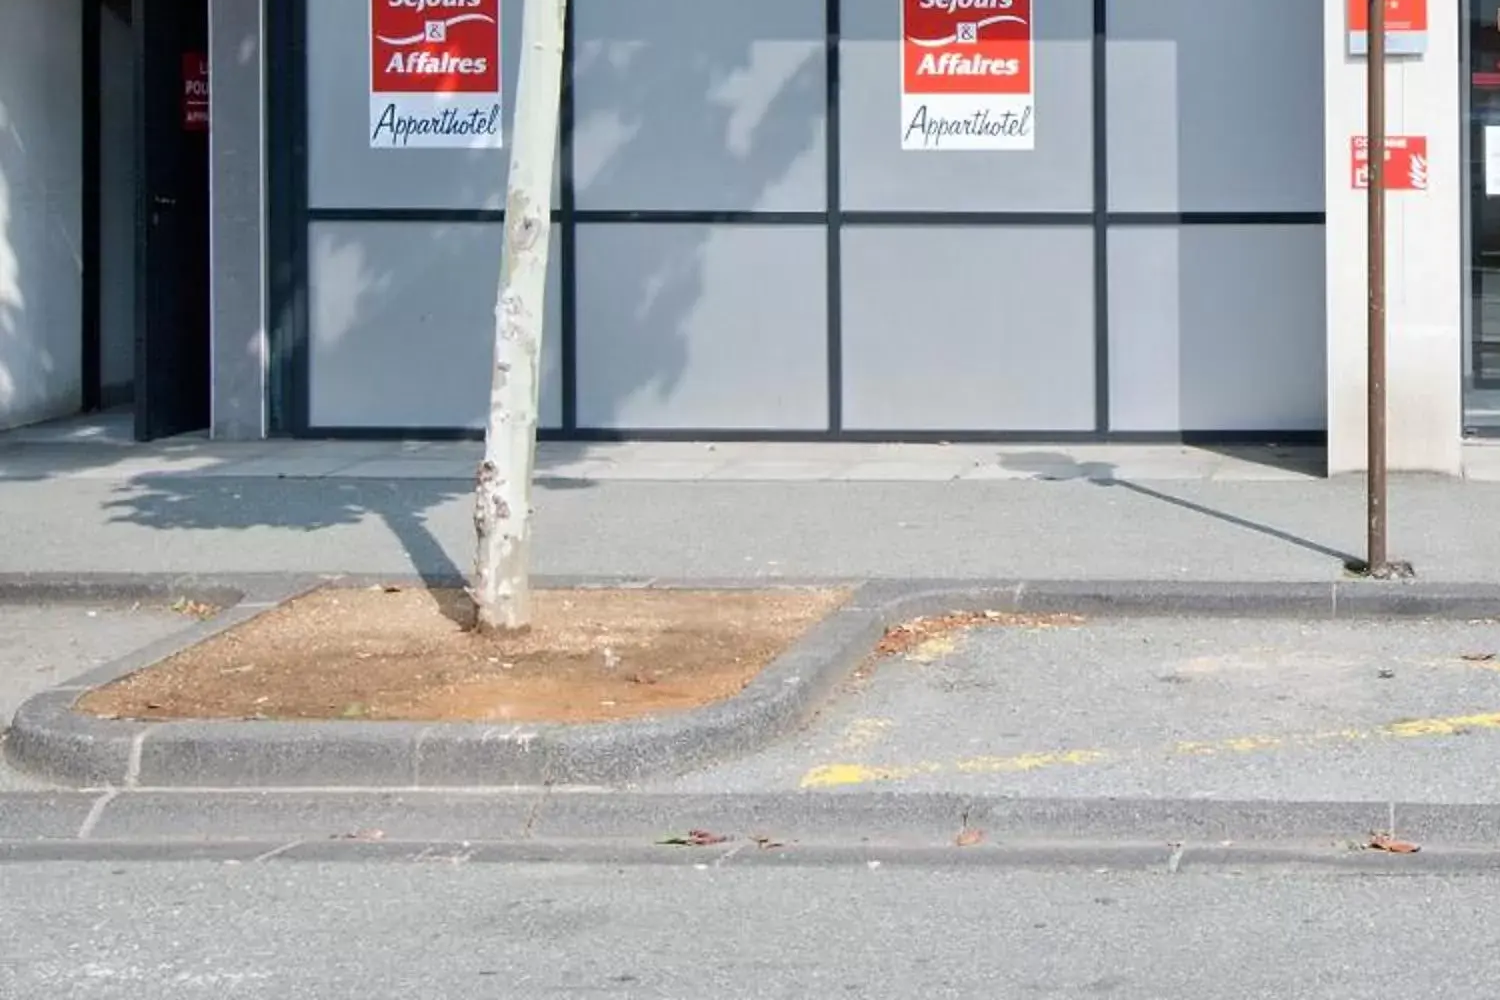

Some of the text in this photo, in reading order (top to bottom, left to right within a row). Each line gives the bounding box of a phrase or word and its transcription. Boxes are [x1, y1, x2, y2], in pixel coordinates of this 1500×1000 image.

[385, 51, 488, 74] Affaires
[917, 53, 1020, 76] Affaires
[373, 103, 500, 145] Apparthotel
[904, 104, 1031, 146] Apparthotel
